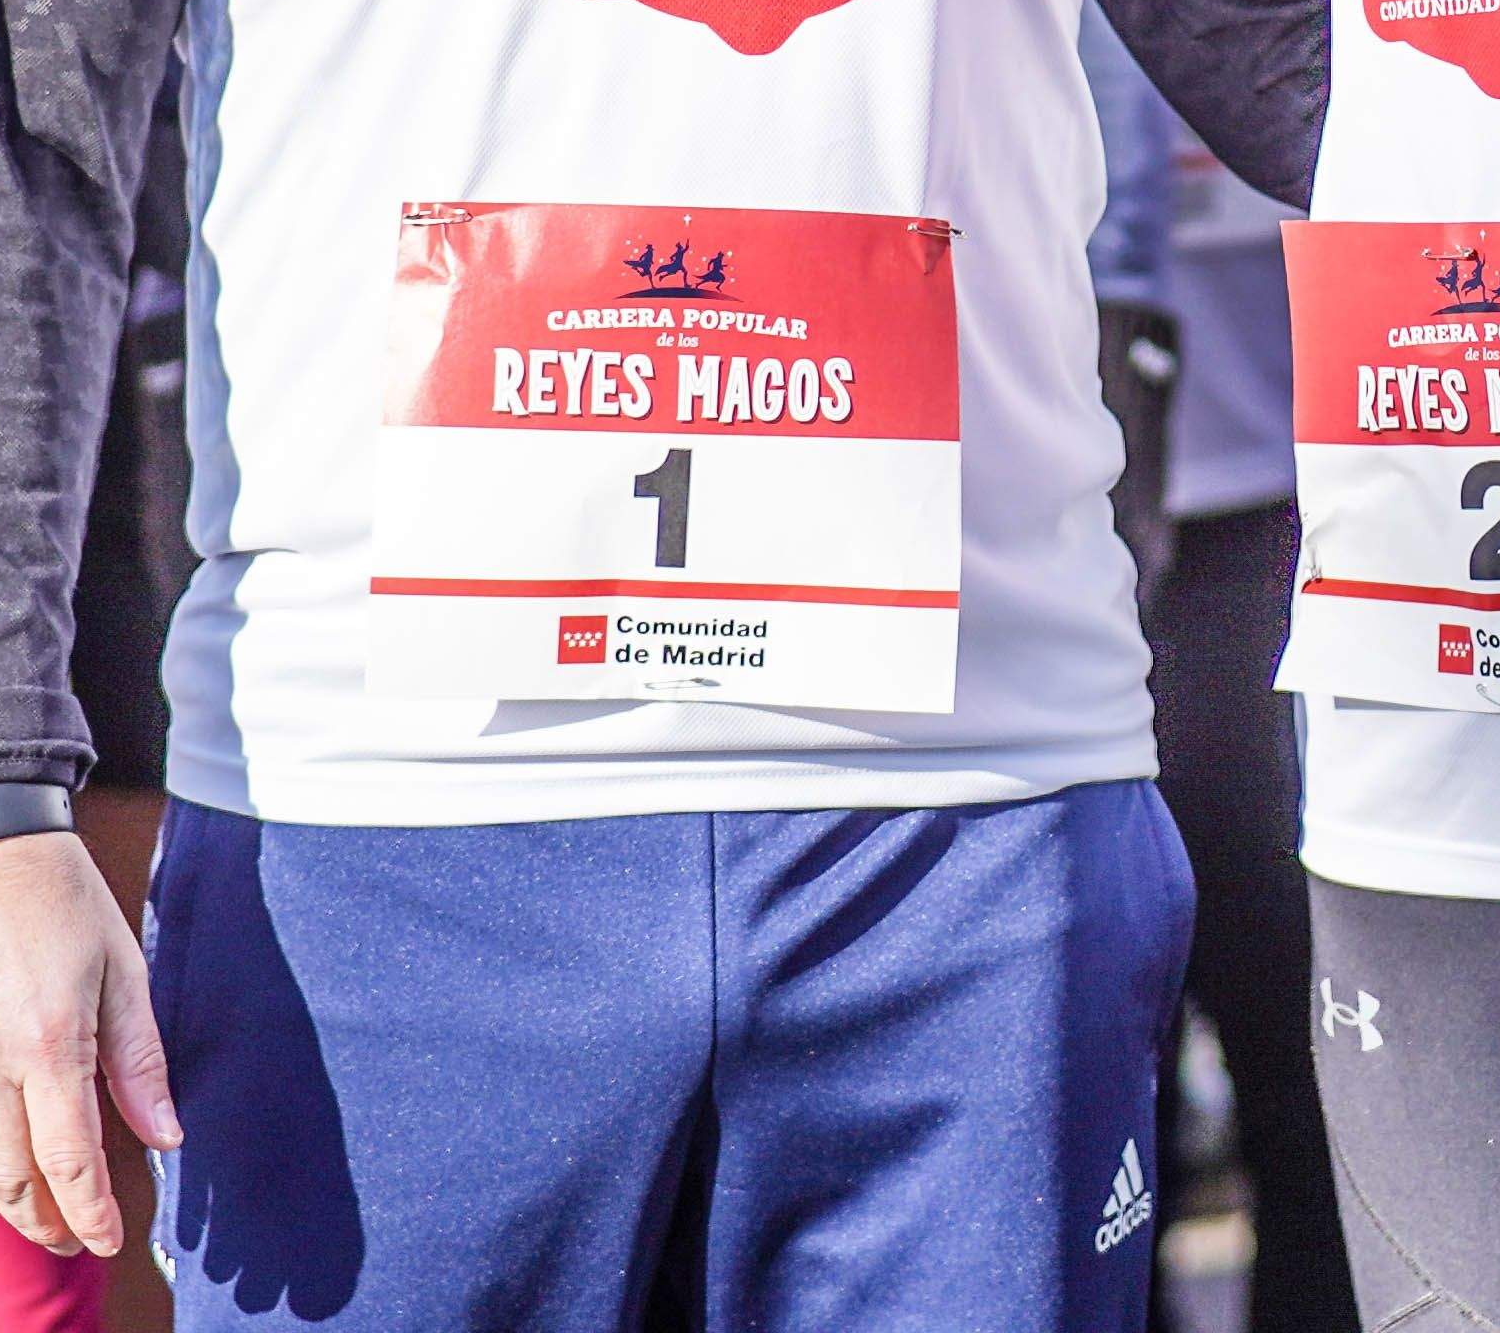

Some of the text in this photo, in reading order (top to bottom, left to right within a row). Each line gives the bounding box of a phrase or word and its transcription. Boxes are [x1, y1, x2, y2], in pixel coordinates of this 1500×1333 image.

[546, 307, 809, 340] CARRERA POPULAR
[1387, 322, 1479, 348] CARRERA
[656, 333, 699, 348] de los
[1464, 346, 1500, 361] de los
[491, 346, 855, 424] REYES MAGOS
[1357, 364, 1470, 433] REYES
[633, 448, 693, 569] 1
[616, 615, 768, 638] Comunidad
[615, 643, 766, 667] de Madrid
[1094, 1191, 1153, 1254] adidas
